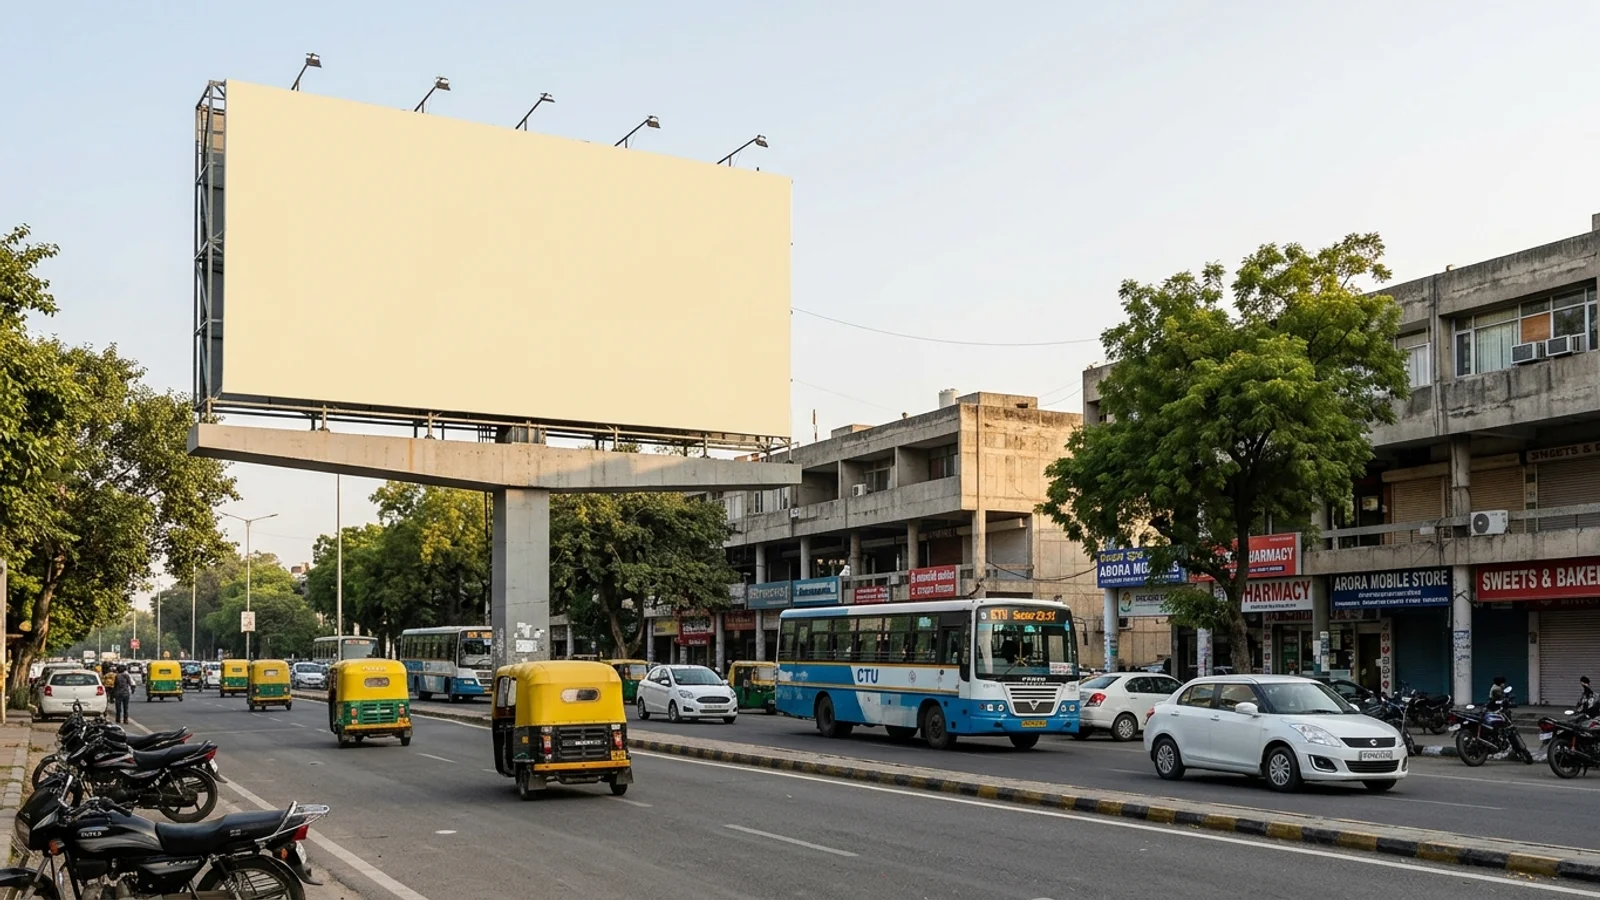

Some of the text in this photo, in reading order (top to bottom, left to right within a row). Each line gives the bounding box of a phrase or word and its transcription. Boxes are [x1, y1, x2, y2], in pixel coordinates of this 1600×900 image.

[1249, 547, 1294, 563] HARMACY
[1334, 570, 1448, 592] ARORA MOBILE STORE
[1482, 568, 1537, 591] SWEETS
[1541, 568, 1552, 588] &
[1244, 580, 1311, 603] HARMACY
[857, 668, 879, 684] CTU
